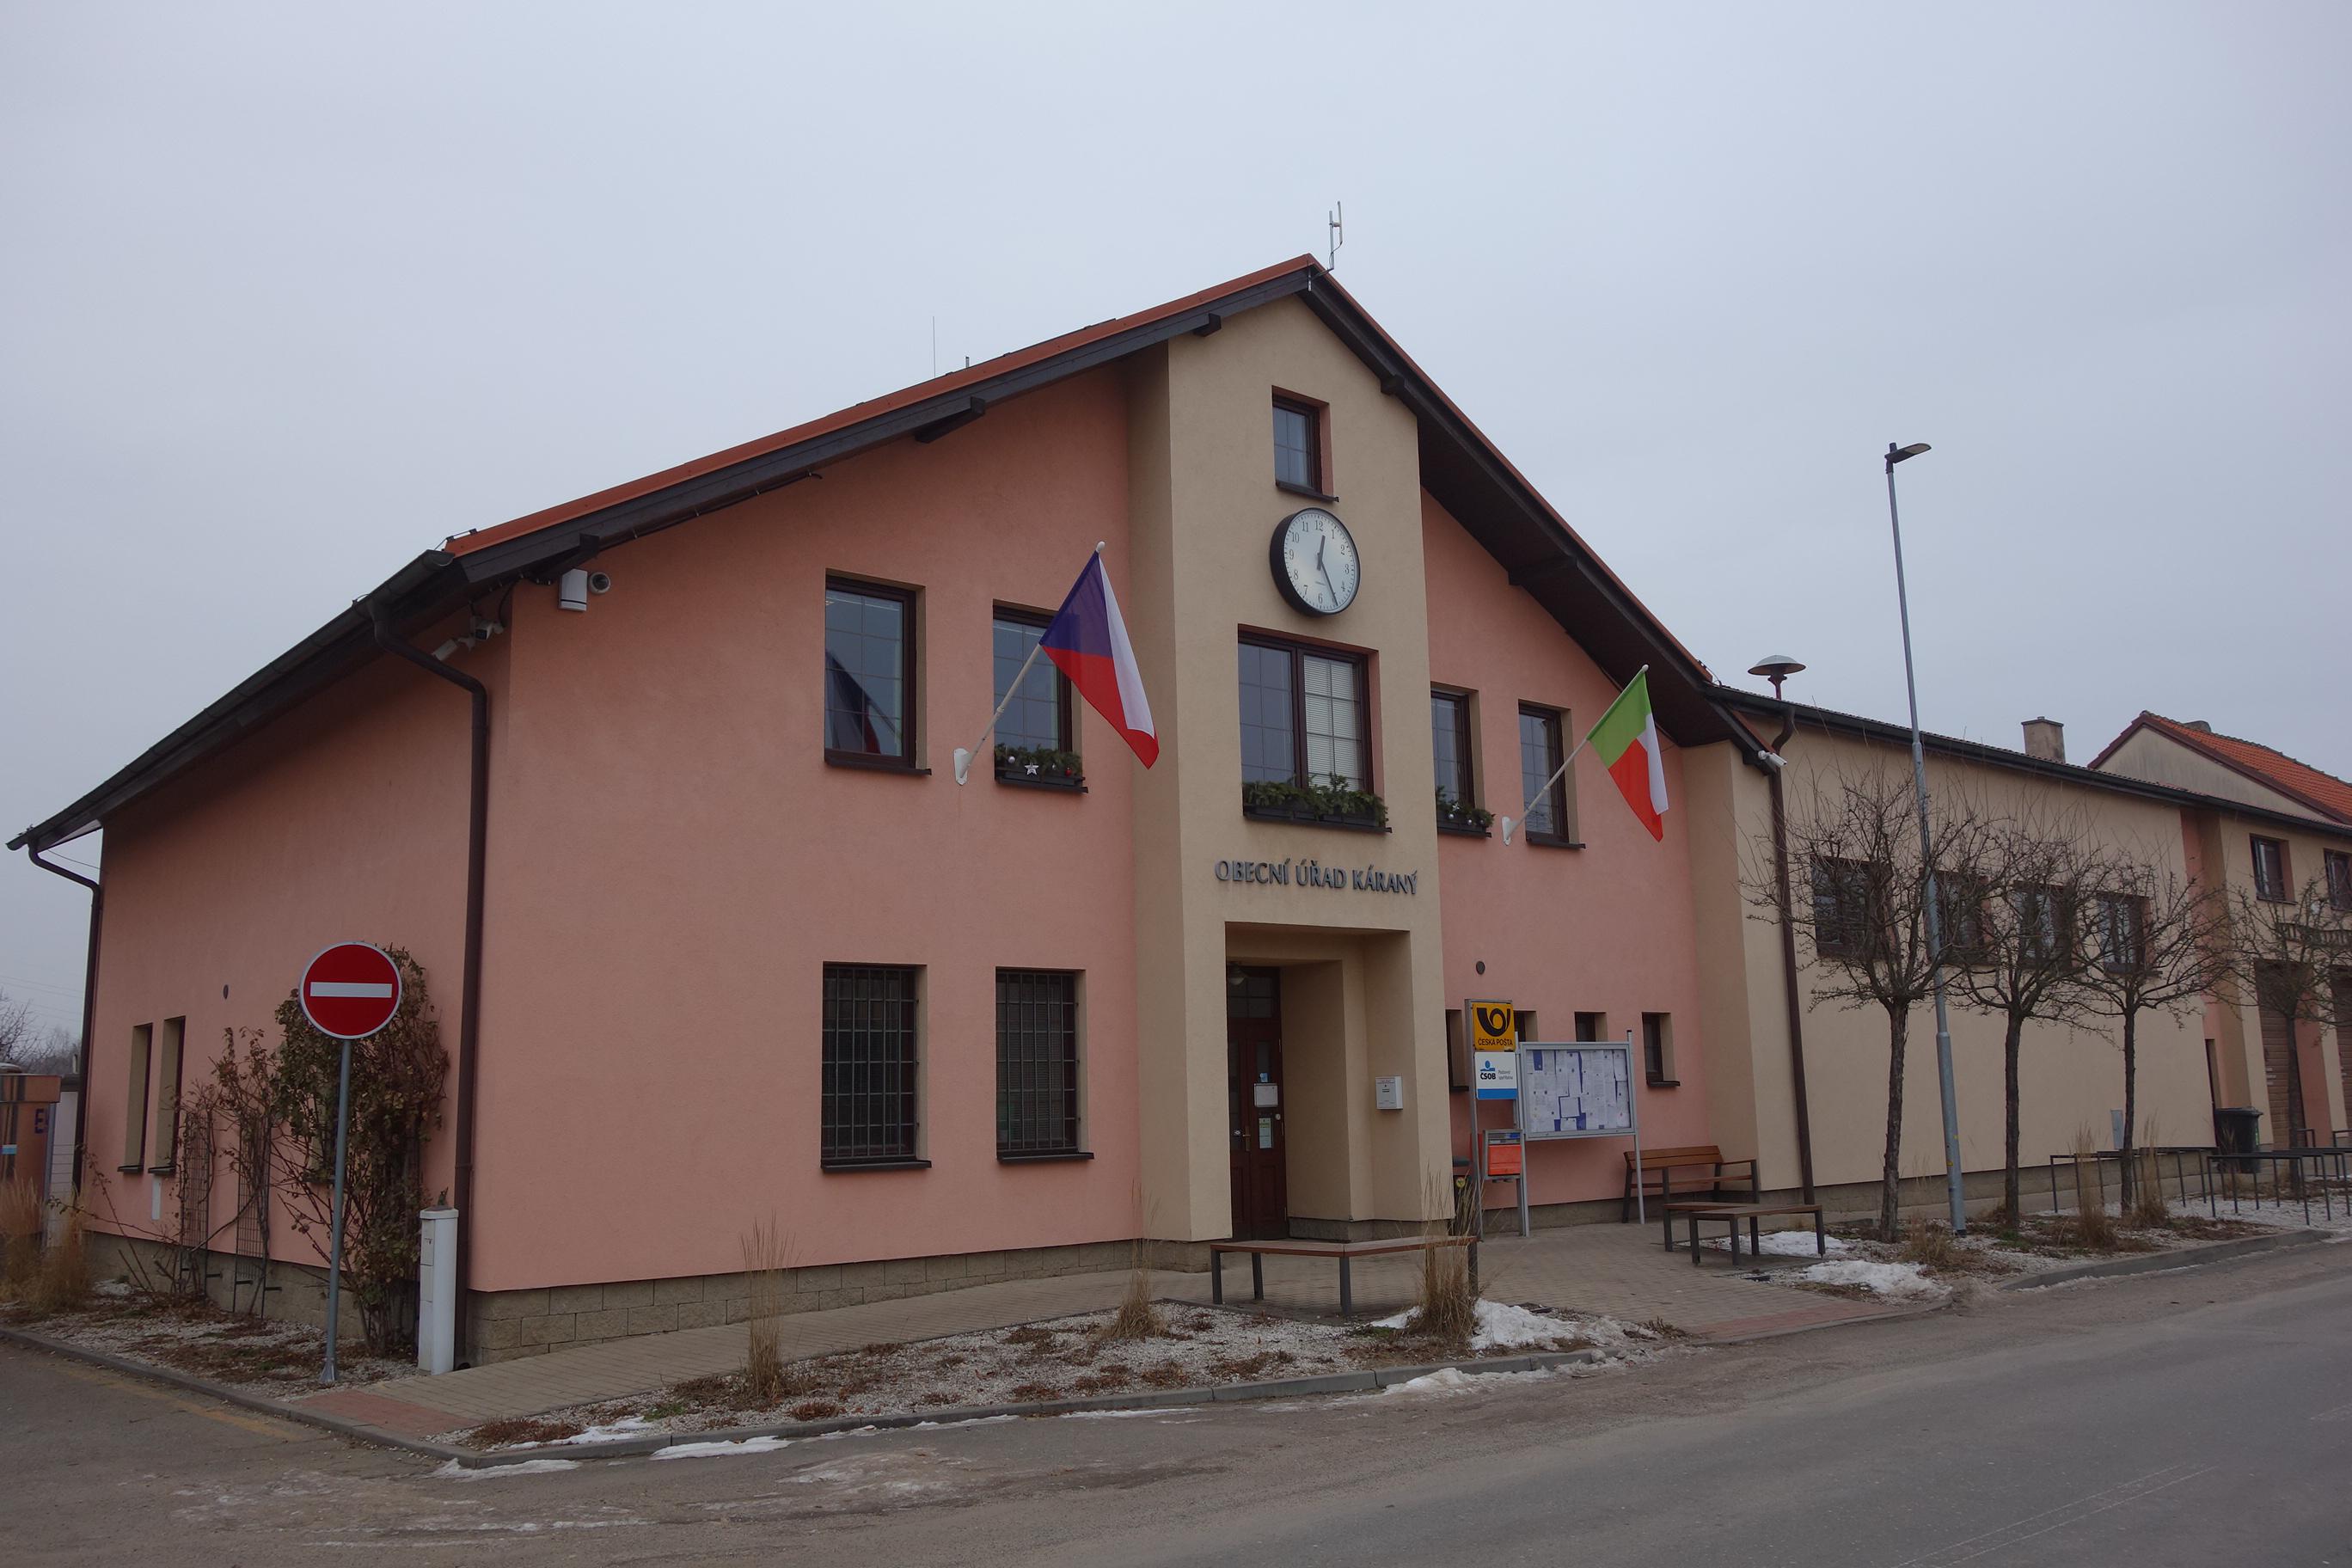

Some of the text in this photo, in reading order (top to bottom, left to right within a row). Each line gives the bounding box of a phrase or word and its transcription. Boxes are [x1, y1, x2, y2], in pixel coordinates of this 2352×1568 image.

[1302, 521, 1309, 533] 11
[1314, 519, 1324, 532] 12
[1291, 531, 1300, 544] 10
[1289, 548, 1295, 560] 9
[1341, 545, 1345, 555] 2
[1293, 569, 1299, 580] 8
[1344, 563, 1350, 575] 3
[1303, 585, 1308, 596] 7
[1318, 593, 1323, 603] 6
[1215, 858, 1418, 894] OBECNÍ ÚŘAD KÁRANÝ
